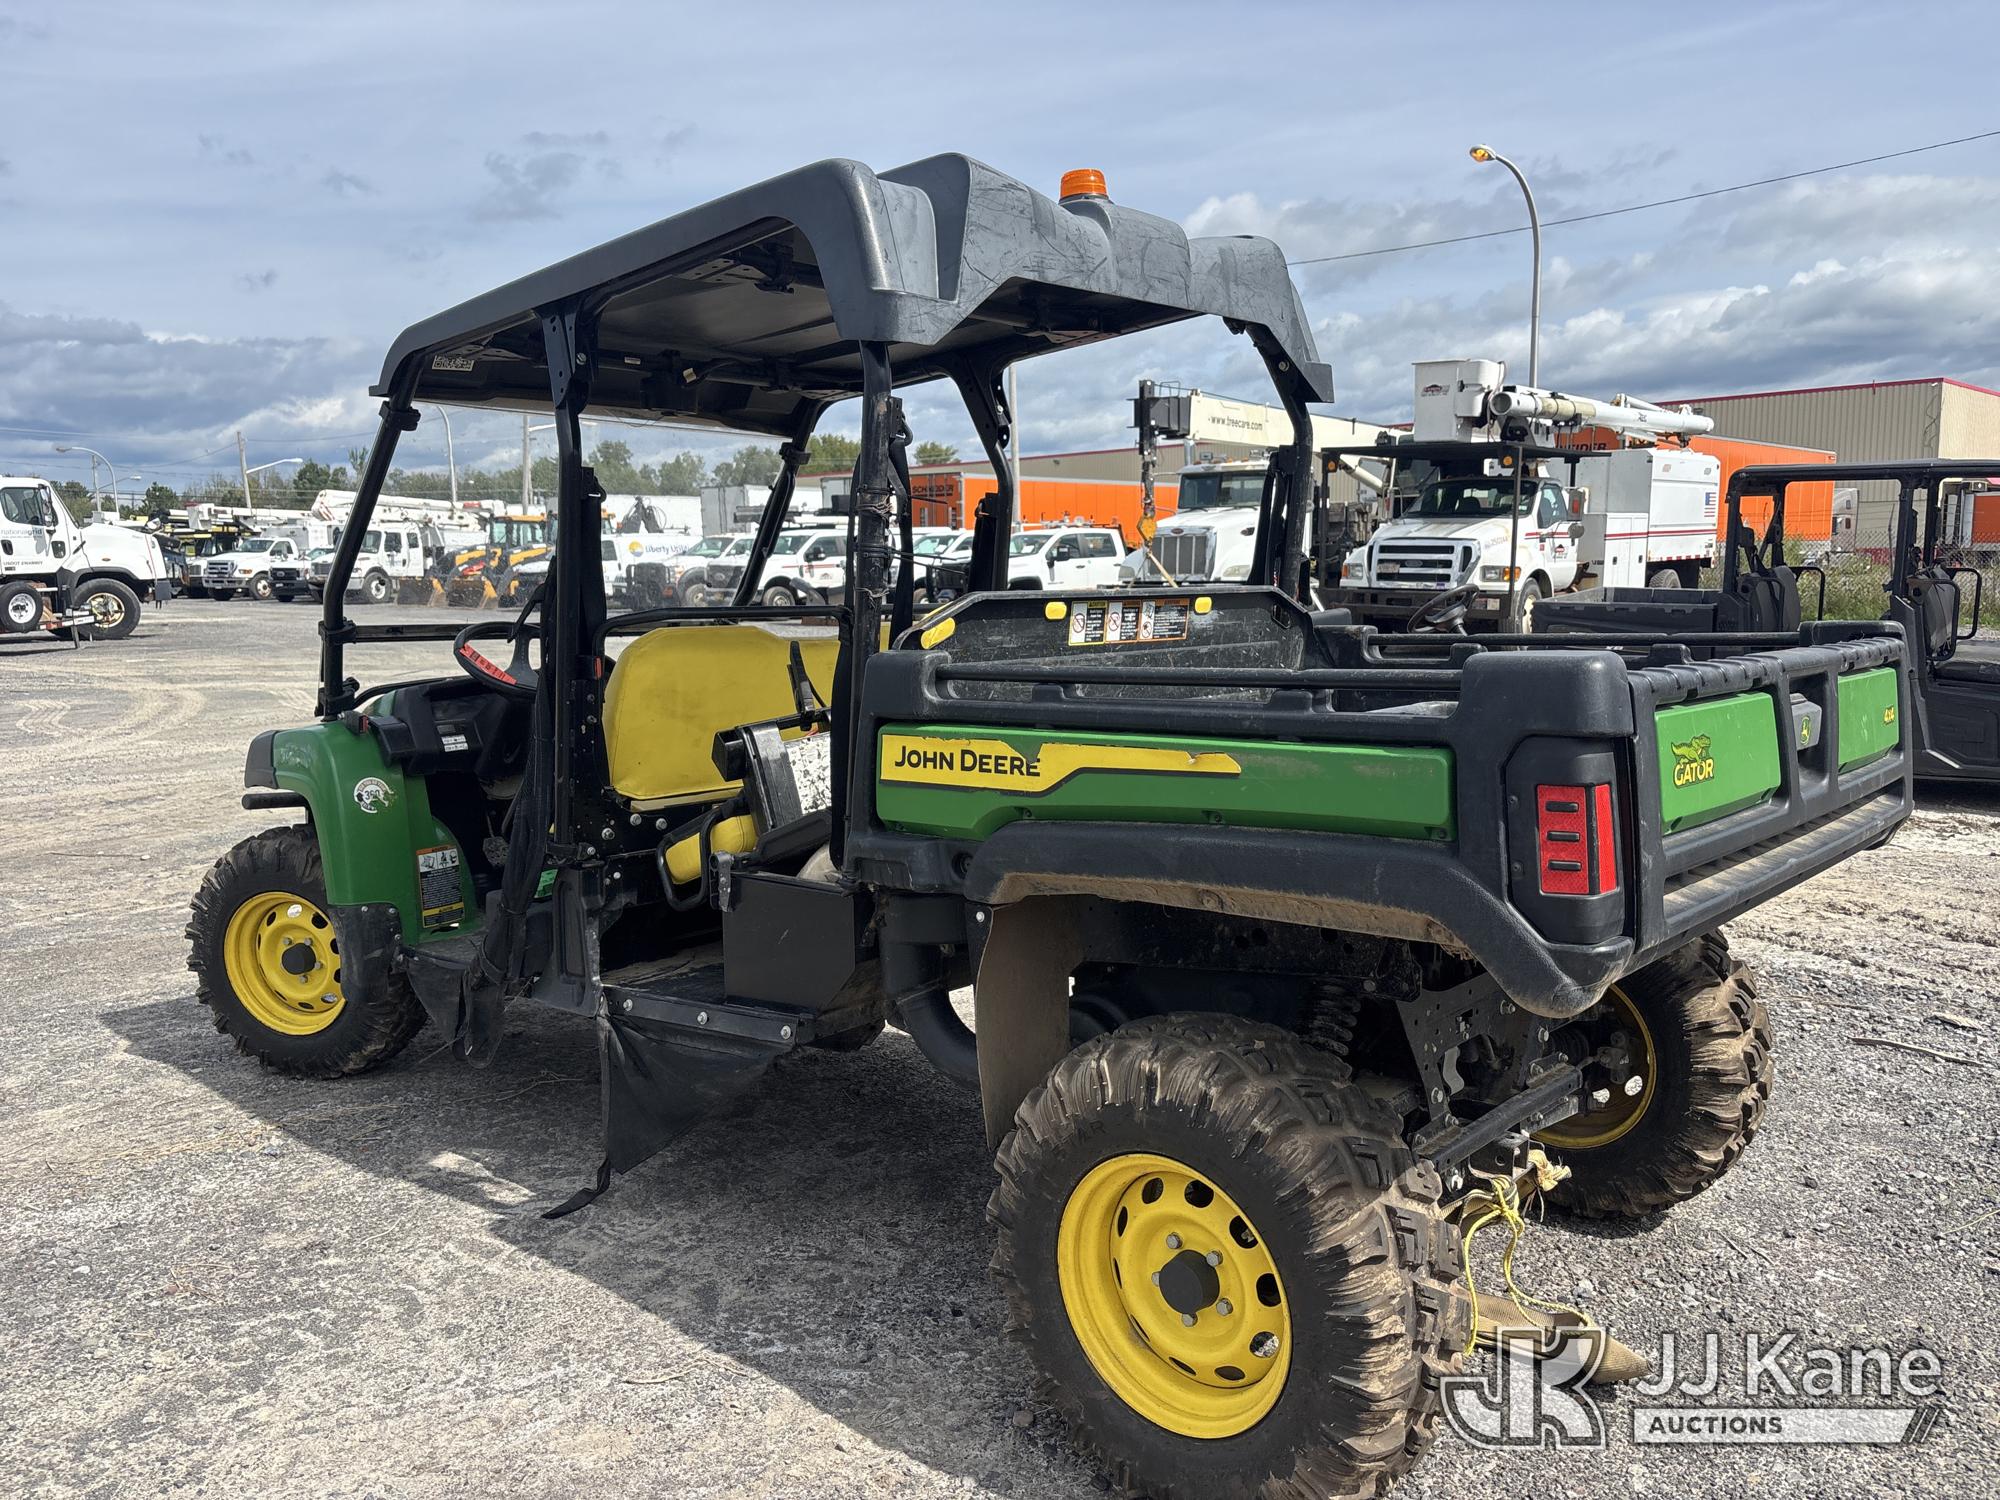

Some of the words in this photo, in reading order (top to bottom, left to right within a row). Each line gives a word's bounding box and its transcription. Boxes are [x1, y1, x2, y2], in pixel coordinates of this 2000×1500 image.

[895, 745, 954, 770] JOHN
[960, 749, 1041, 777] DEERE
[1674, 758, 1713, 784] GATOR
